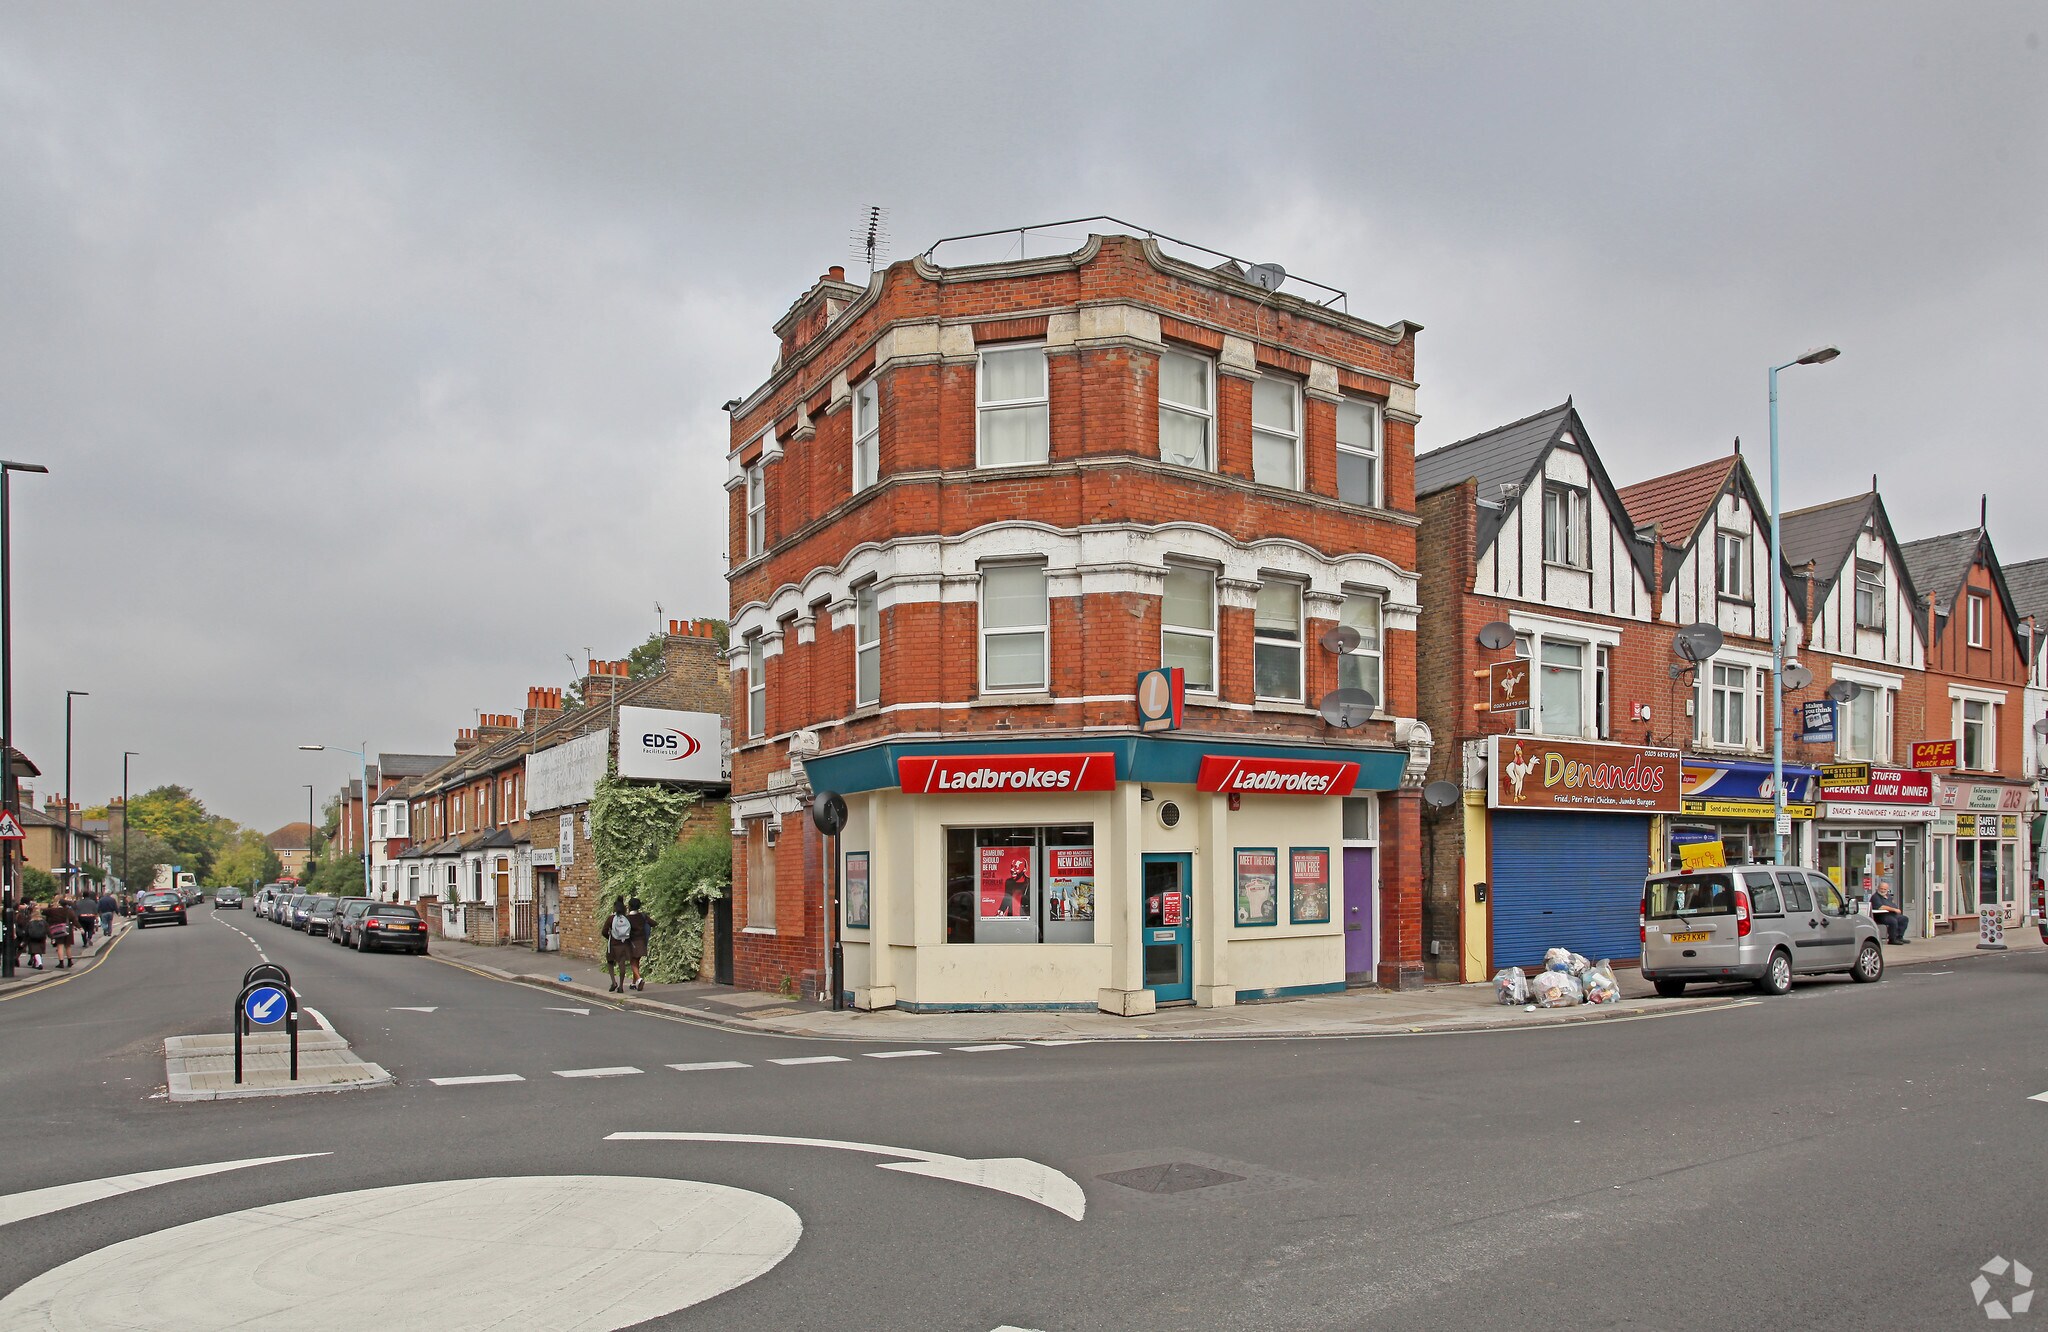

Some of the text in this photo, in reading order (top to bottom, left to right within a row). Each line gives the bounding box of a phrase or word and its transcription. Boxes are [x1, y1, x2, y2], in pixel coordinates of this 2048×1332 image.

[1148, 676, 1162, 712] L
[642, 734, 677, 748] EDS
[1917, 744, 1953, 756] CAFE
[1545, 752, 1664, 792] Denandos
[1872, 772, 1901, 781] STUFFED
[938, 768, 1071, 789] Ladbrokes
[1232, 769, 1329, 791] Ladbrokes
[1874, 785, 1899, 795] LUNCH
[1902, 786, 1928, 797] DINNER
[1554, 795, 1570, 803] Fried,
[1596, 796, 1618, 805] Chicken,
[1619, 797, 1635, 805] Jumbo
[1636, 798, 1656, 807] Burgers
[2003, 790, 2021, 808] 213
[1957, 816, 1975, 824] PICTURE
[1980, 816, 1996, 825] SAFETY
[1957, 827, 1975, 836] FRAMING
[1980, 827, 1995, 835] GLASS
[1058, 857, 1092, 867] NEW GAME
[1240, 856, 1275, 866] MEET THE TEAM
[1295, 861, 1320, 872] WIN FREE
